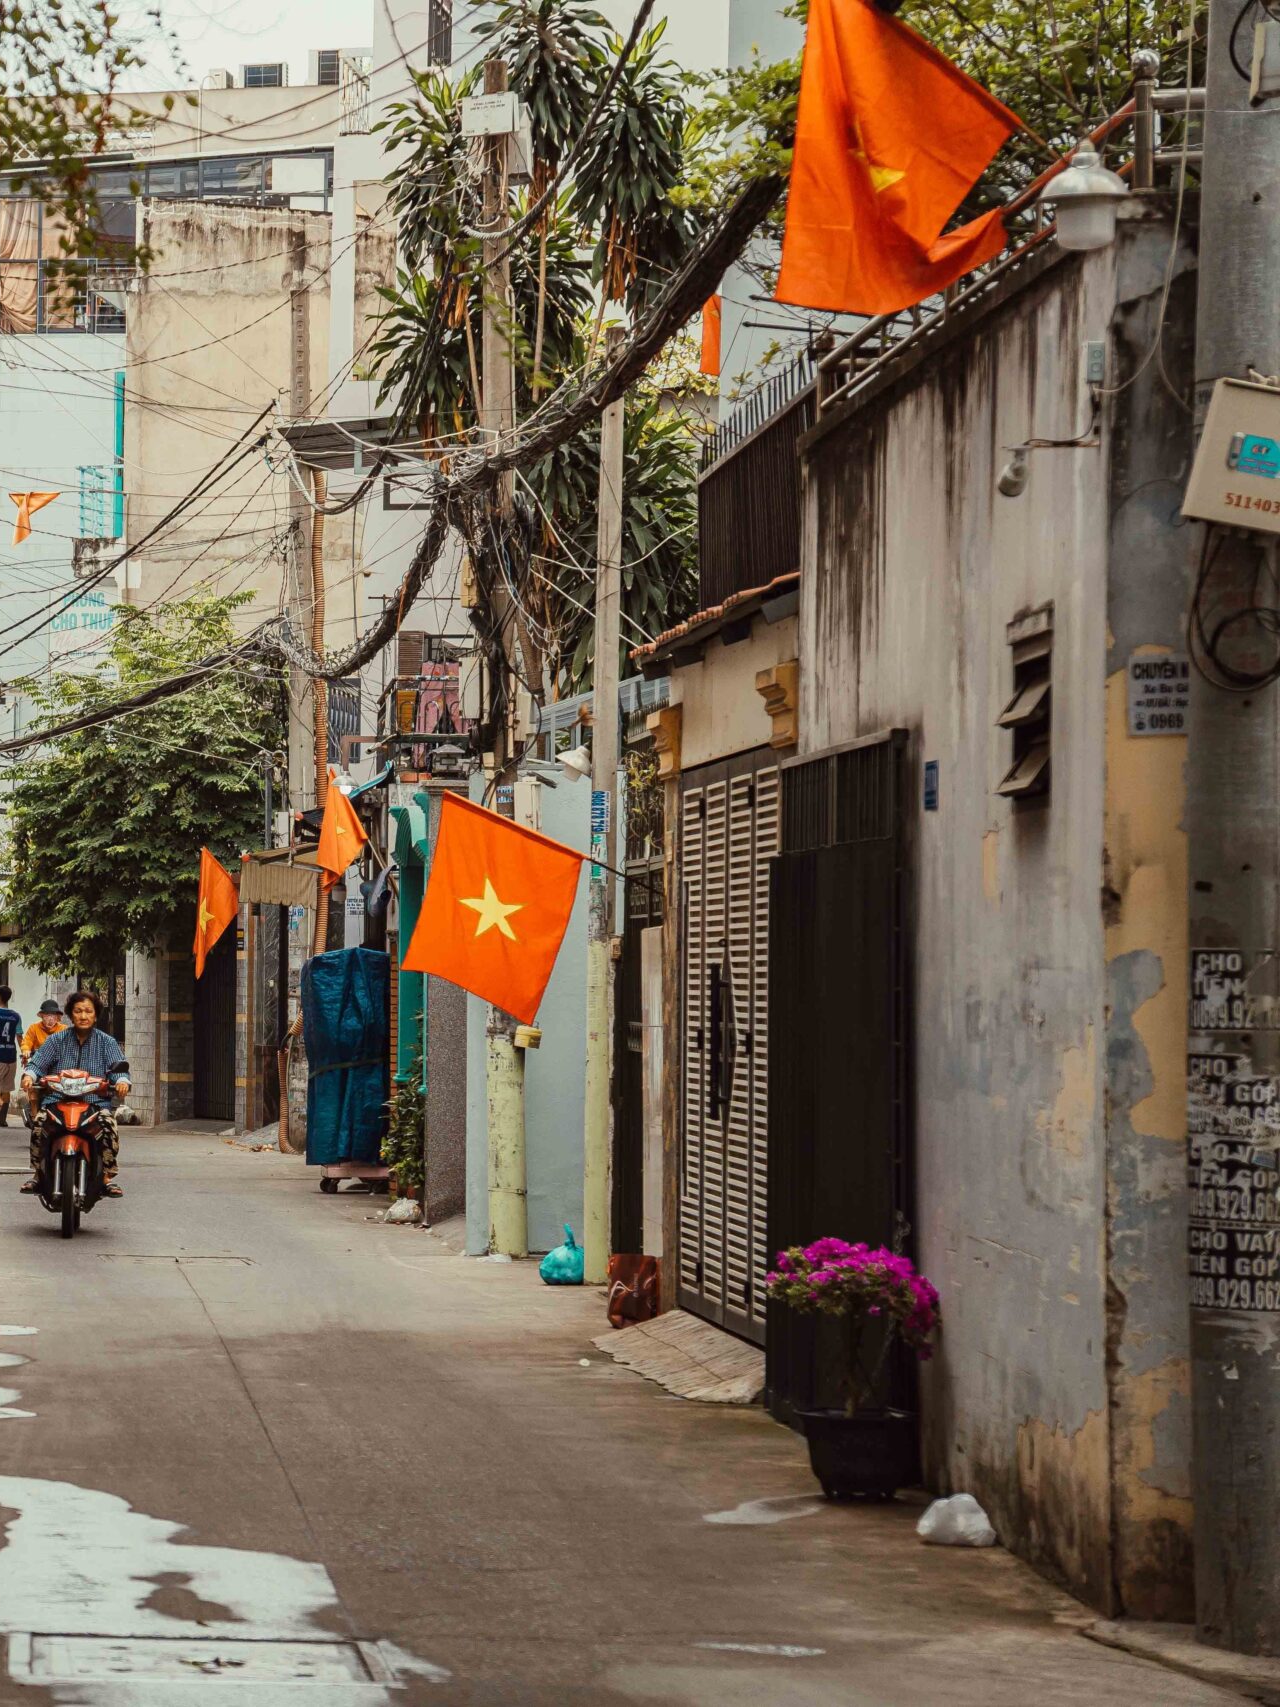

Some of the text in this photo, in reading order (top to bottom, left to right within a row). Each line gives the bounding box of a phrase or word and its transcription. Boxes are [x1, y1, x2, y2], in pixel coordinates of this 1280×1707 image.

[51, 612, 77, 630] CHO
[1197, 953, 1242, 971] CHO
[1, 1022, 10, 1042] 4
[1191, 1230, 1228, 1250] CHO
